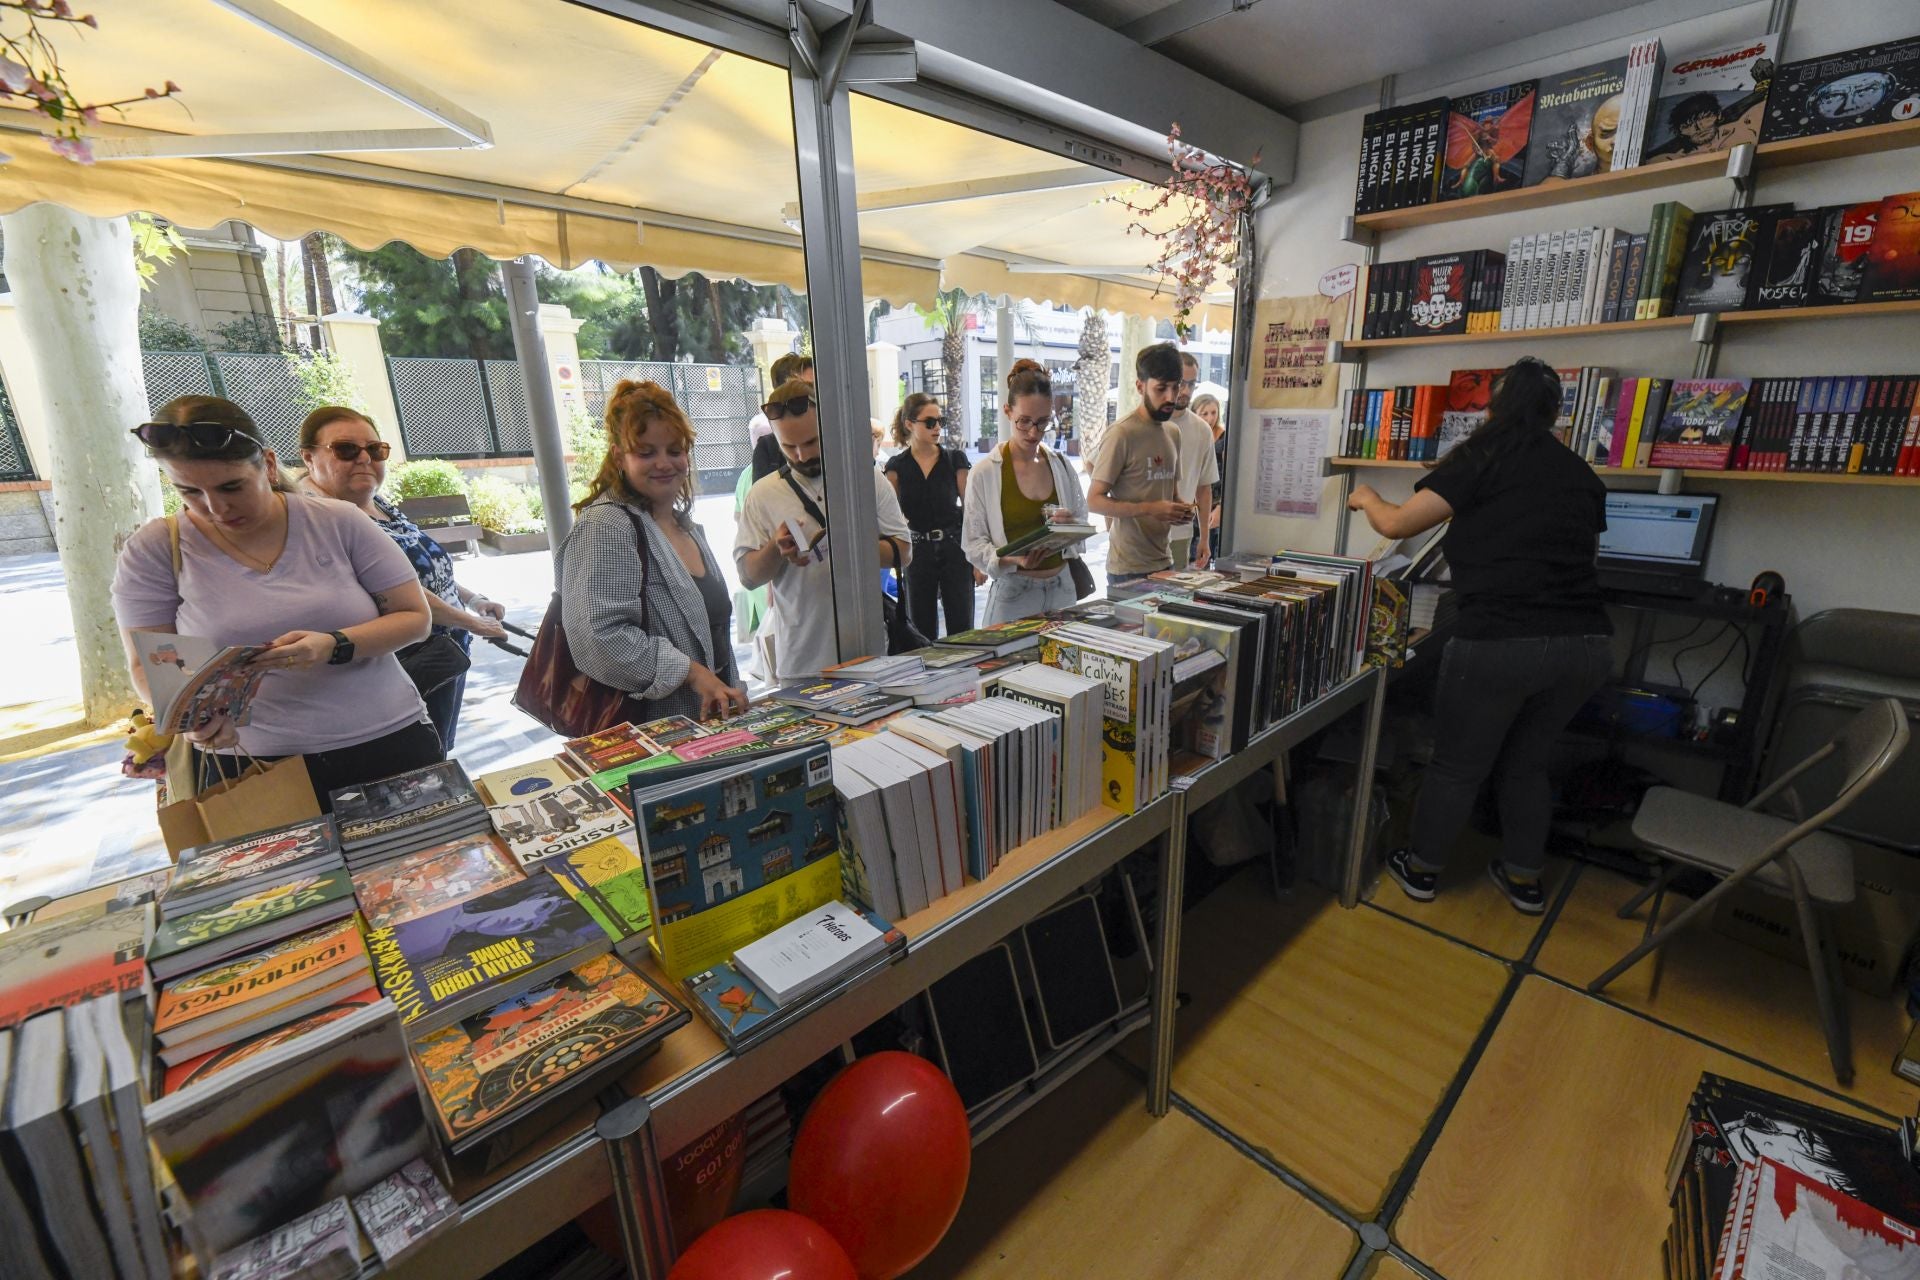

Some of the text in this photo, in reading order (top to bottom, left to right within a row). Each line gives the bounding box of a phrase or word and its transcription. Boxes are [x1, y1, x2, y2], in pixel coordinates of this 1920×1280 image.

[1540, 77, 1624, 109] Metabarones
[1368, 136, 1382, 188] EL INCAL
[1380, 133, 1396, 186] EL INCAL
[1395, 130, 1410, 184] EL INCAL
[1408, 127, 1424, 181] EL INCAL
[1422, 124, 1438, 178] EL INCAL
[1503, 260, 1516, 308] MONSTRUOS
[1516, 259, 1529, 306] MONSTRUOS
[1530, 258, 1542, 306] MONSTRUOS
[1543, 254, 1556, 304] MONSTRUOS
[1556, 252, 1572, 303] MONSTRUOS
[1571, 249, 1586, 301] MONSTRUOS
[1608, 249, 1623, 300] PATOS
[1625, 247, 1641, 298] PATOS
[1682, 417, 1704, 426] TODO
[1706, 423, 1722, 436] MÍ
[522, 819, 630, 862] FASHION
[466, 936, 522, 966] ANIME
[822, 922, 852, 942] Héroes
[430, 967, 484, 1002] LIBRO
[482, 950, 533, 978] GRAN
[480, 994, 612, 1066] MONOGATARI
